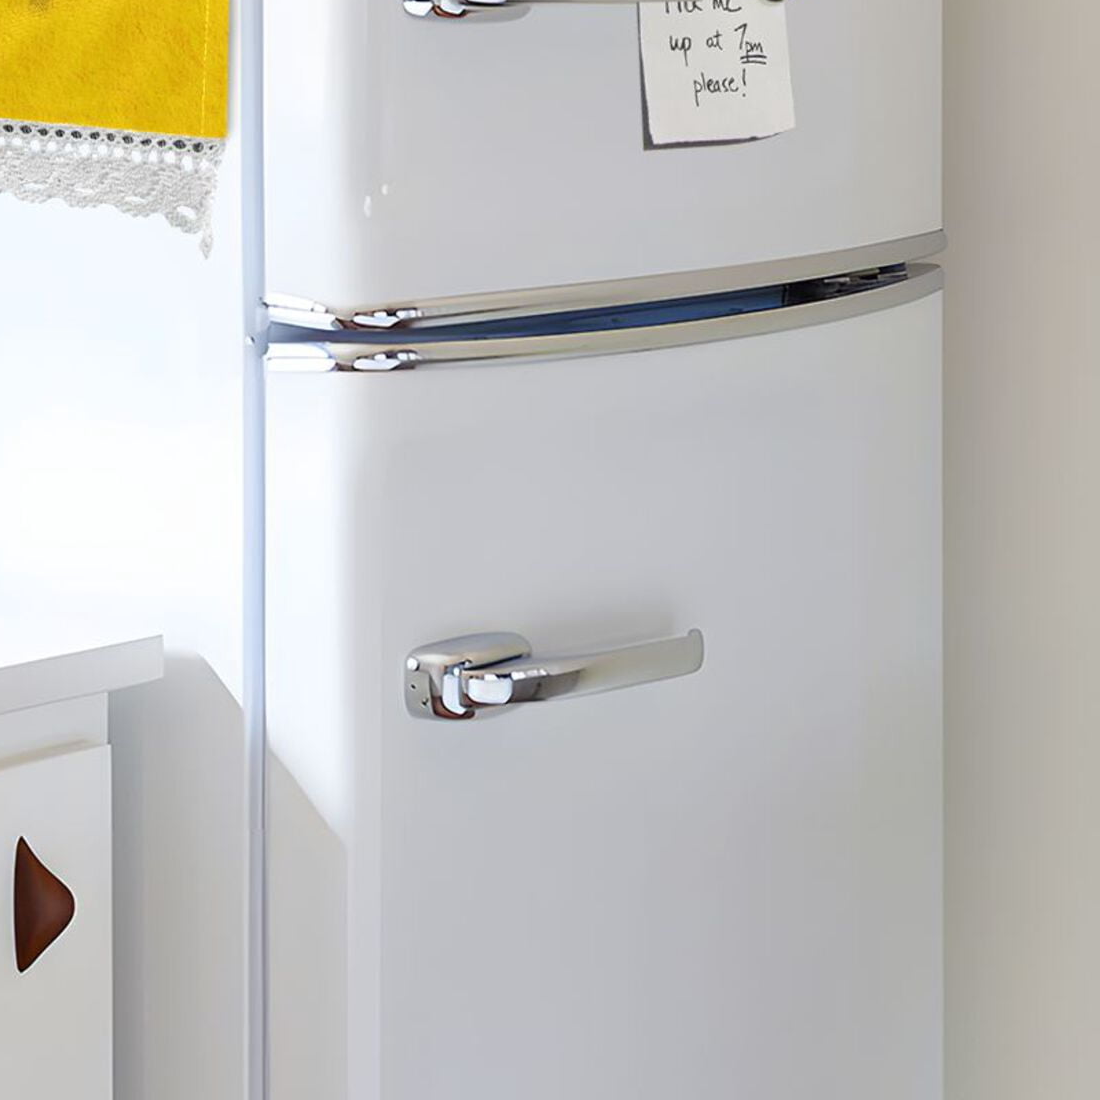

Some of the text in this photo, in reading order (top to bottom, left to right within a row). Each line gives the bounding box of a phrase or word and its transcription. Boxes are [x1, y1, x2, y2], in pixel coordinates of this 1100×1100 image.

[669, 35, 692, 67] up
[706, 29, 723, 51] at
[694, 68, 747, 107] please!
